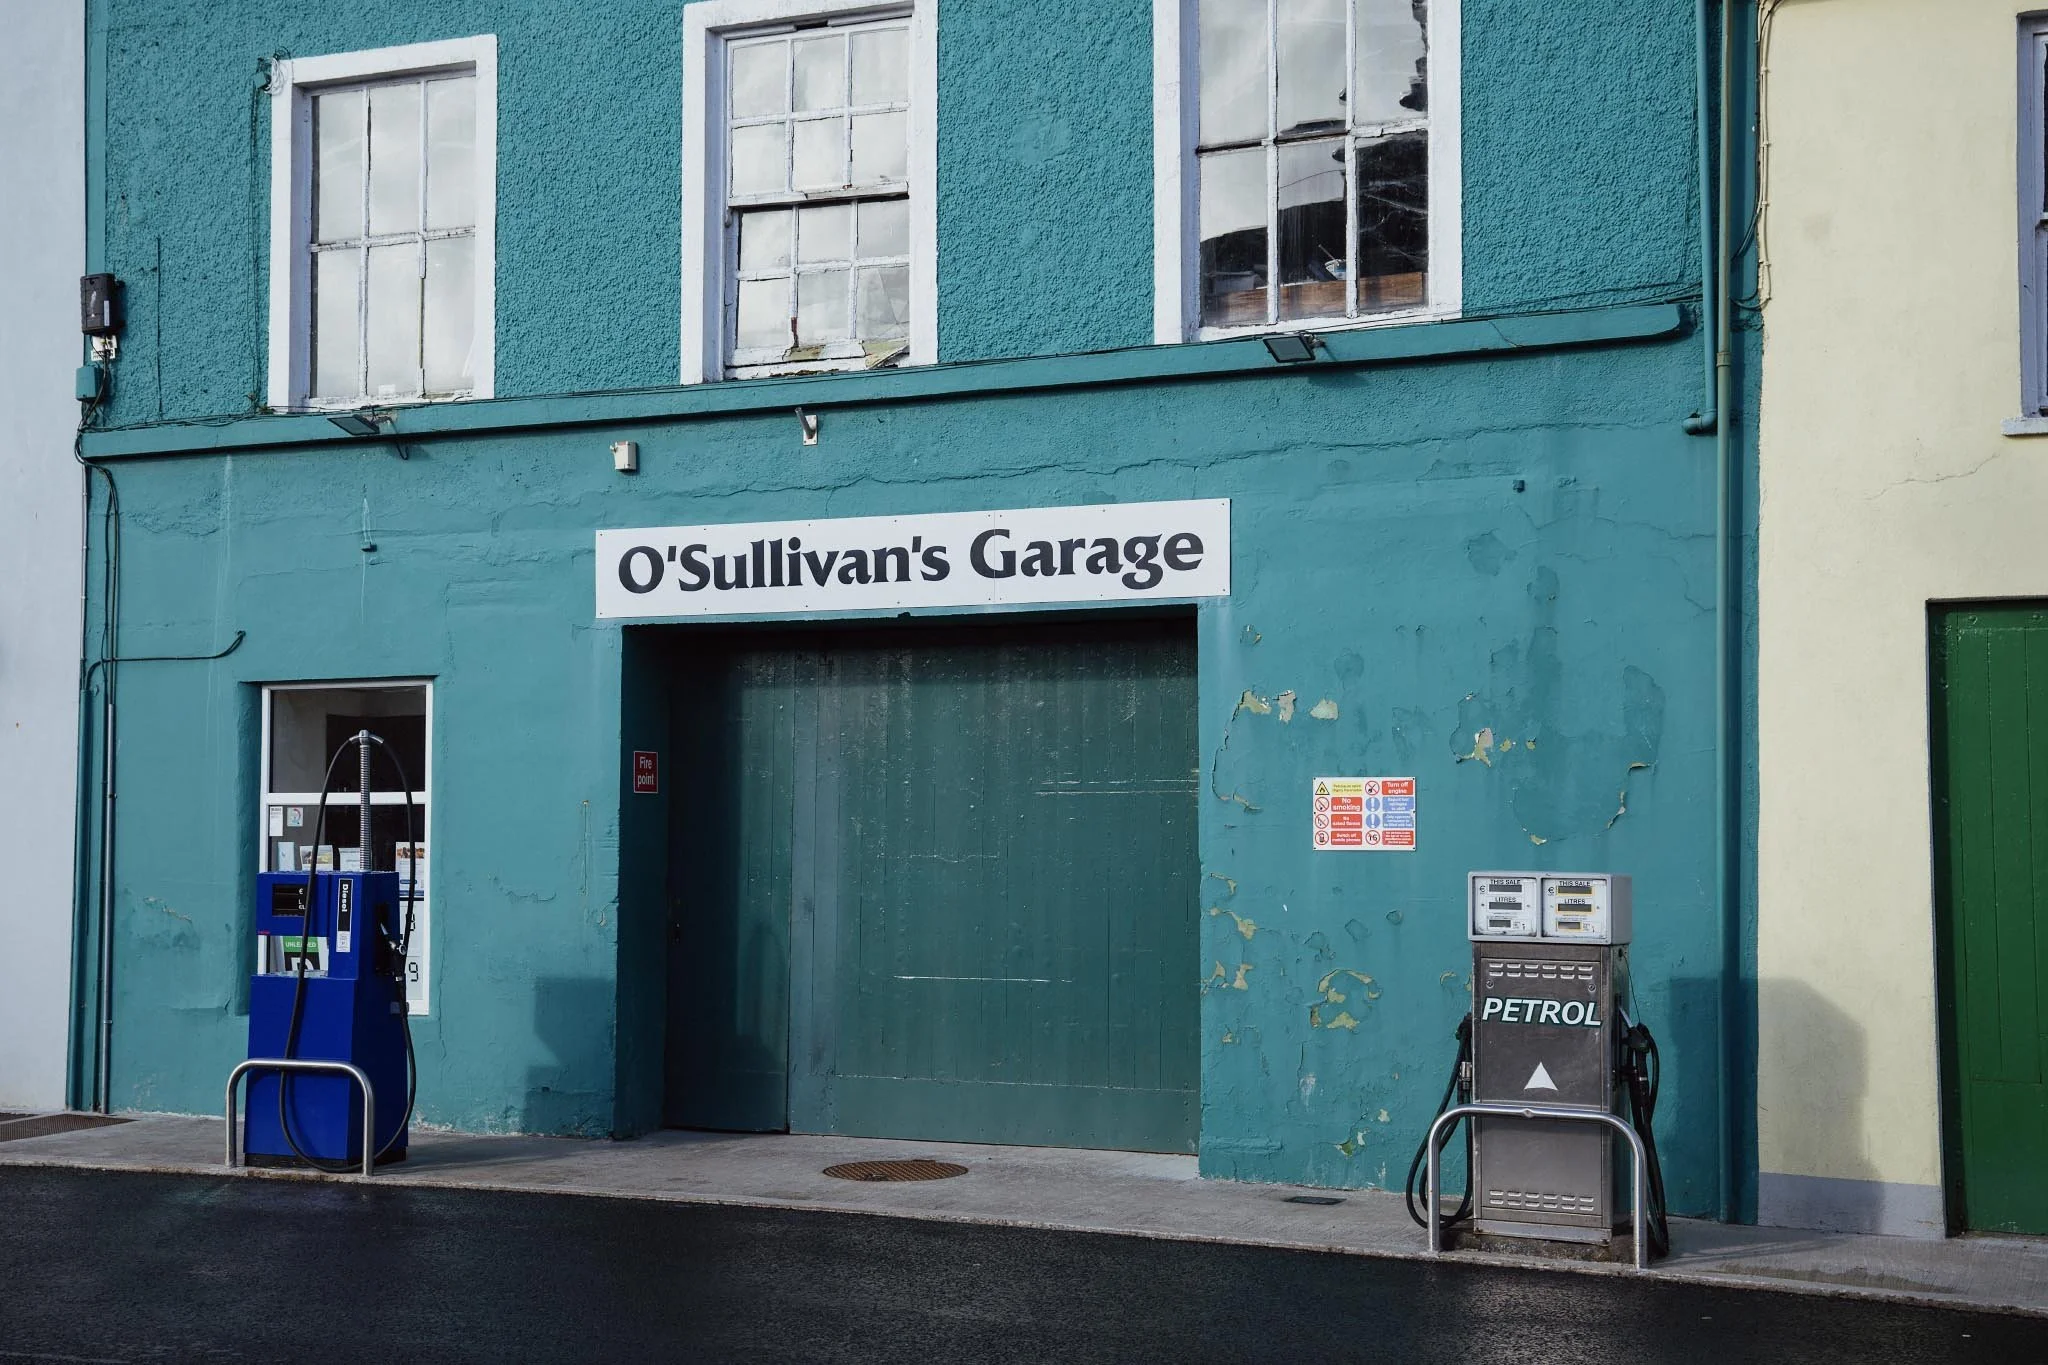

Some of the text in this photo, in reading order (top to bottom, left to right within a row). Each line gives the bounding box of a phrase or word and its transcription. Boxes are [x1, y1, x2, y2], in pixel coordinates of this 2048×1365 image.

[618, 528, 1204, 594] O'Sullivan's Garage
[639, 756, 653, 770] Fire
[637, 772, 654, 788] point
[1333, 804, 1361, 812] smoking
[341, 883, 349, 912] Diesel
[1481, 997, 1602, 1026] PETROL
